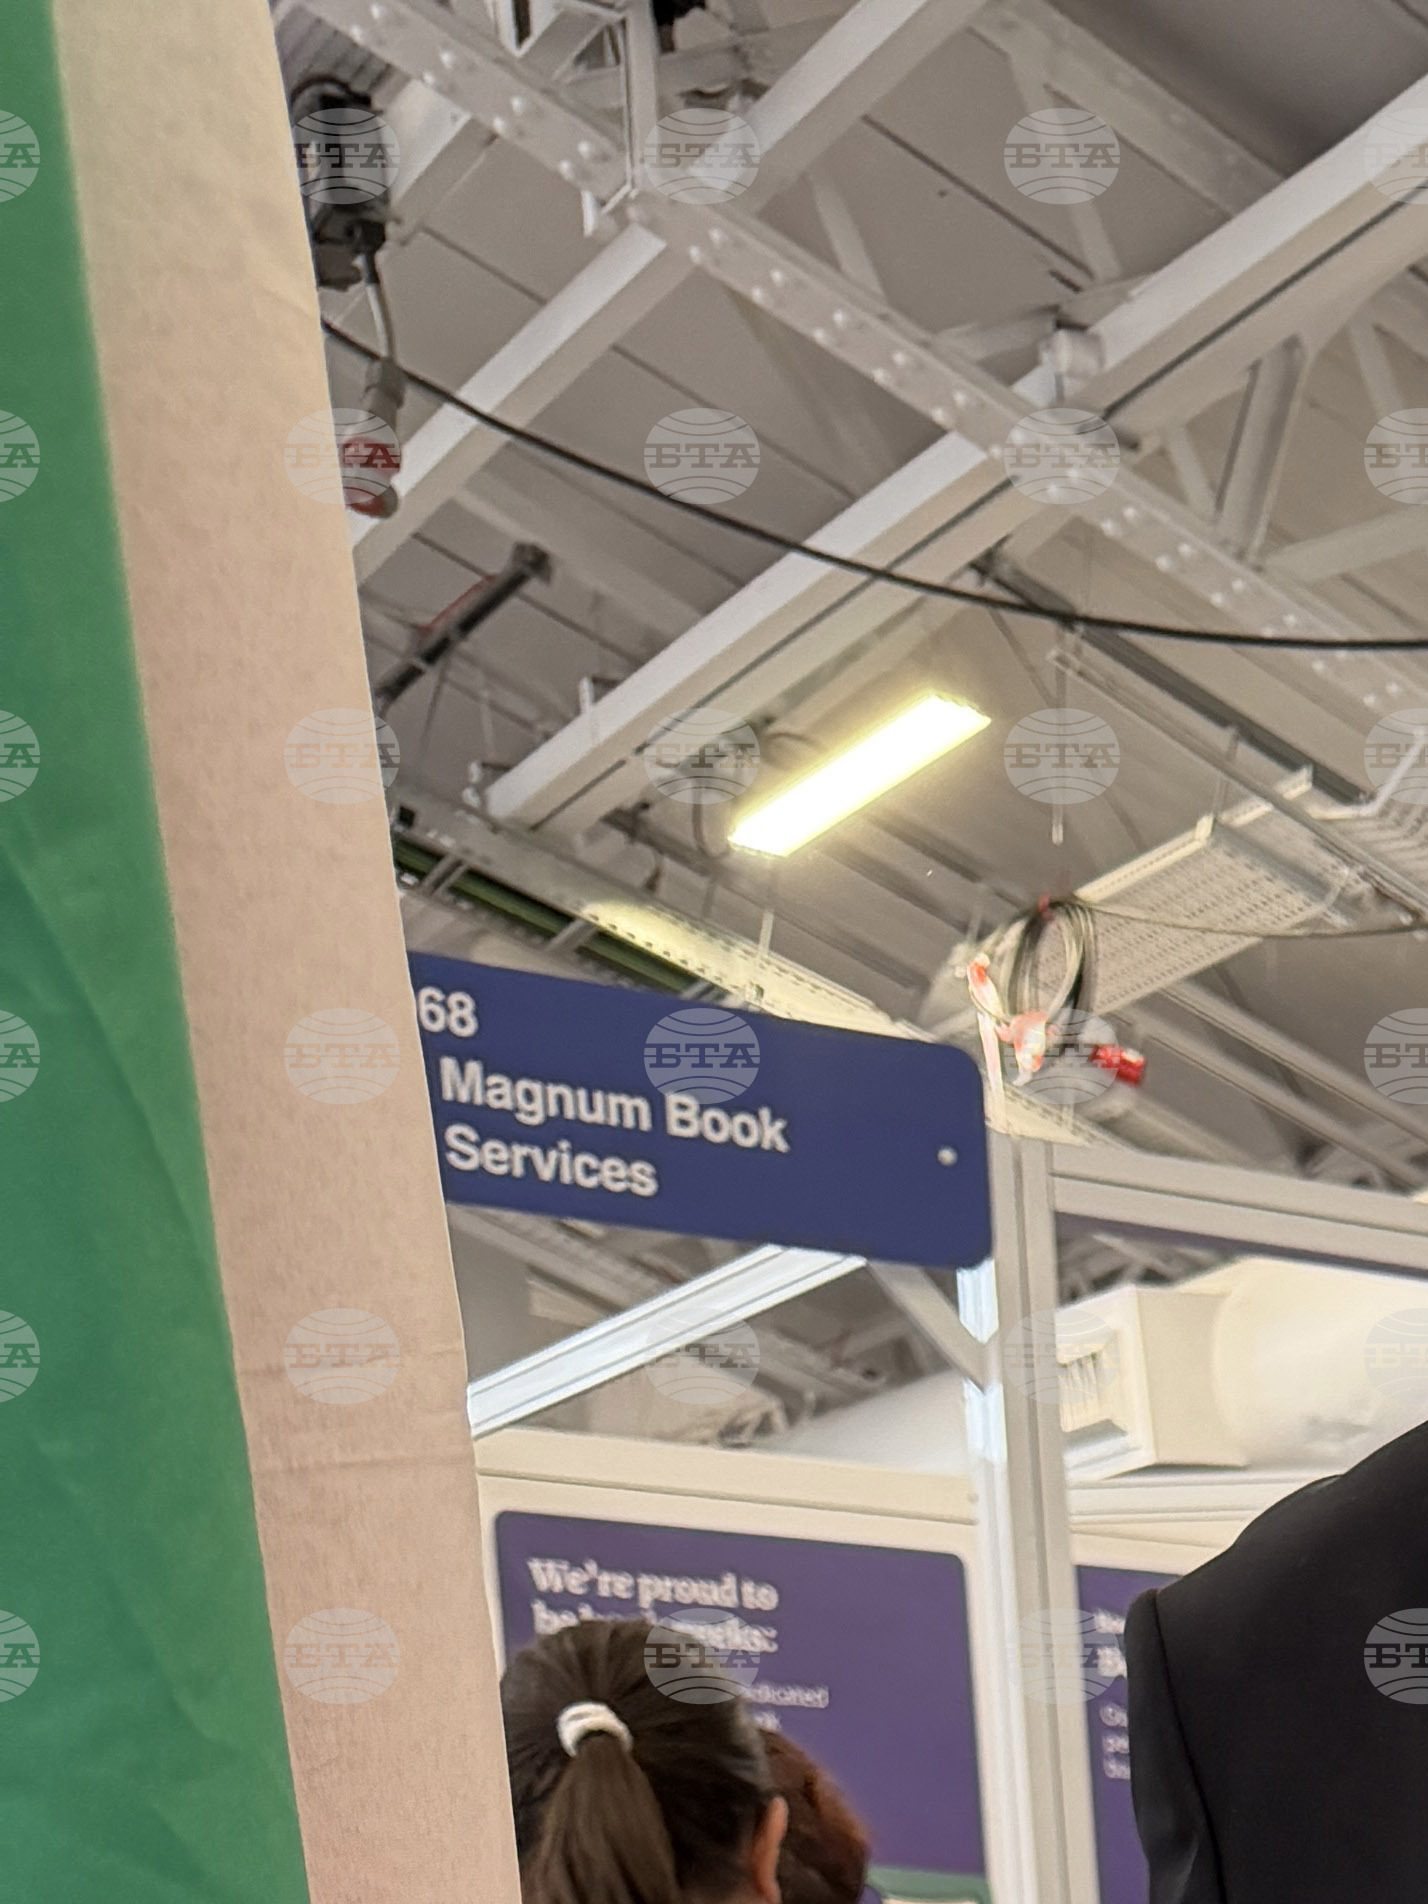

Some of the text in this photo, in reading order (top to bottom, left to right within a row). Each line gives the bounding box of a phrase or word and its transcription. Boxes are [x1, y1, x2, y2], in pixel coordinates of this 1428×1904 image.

[418, 986, 479, 1038] 68
[439, 1056, 790, 1154] Magnum Book
[444, 1122, 659, 1198] Services
[527, 1557, 779, 1612] We're proud to
